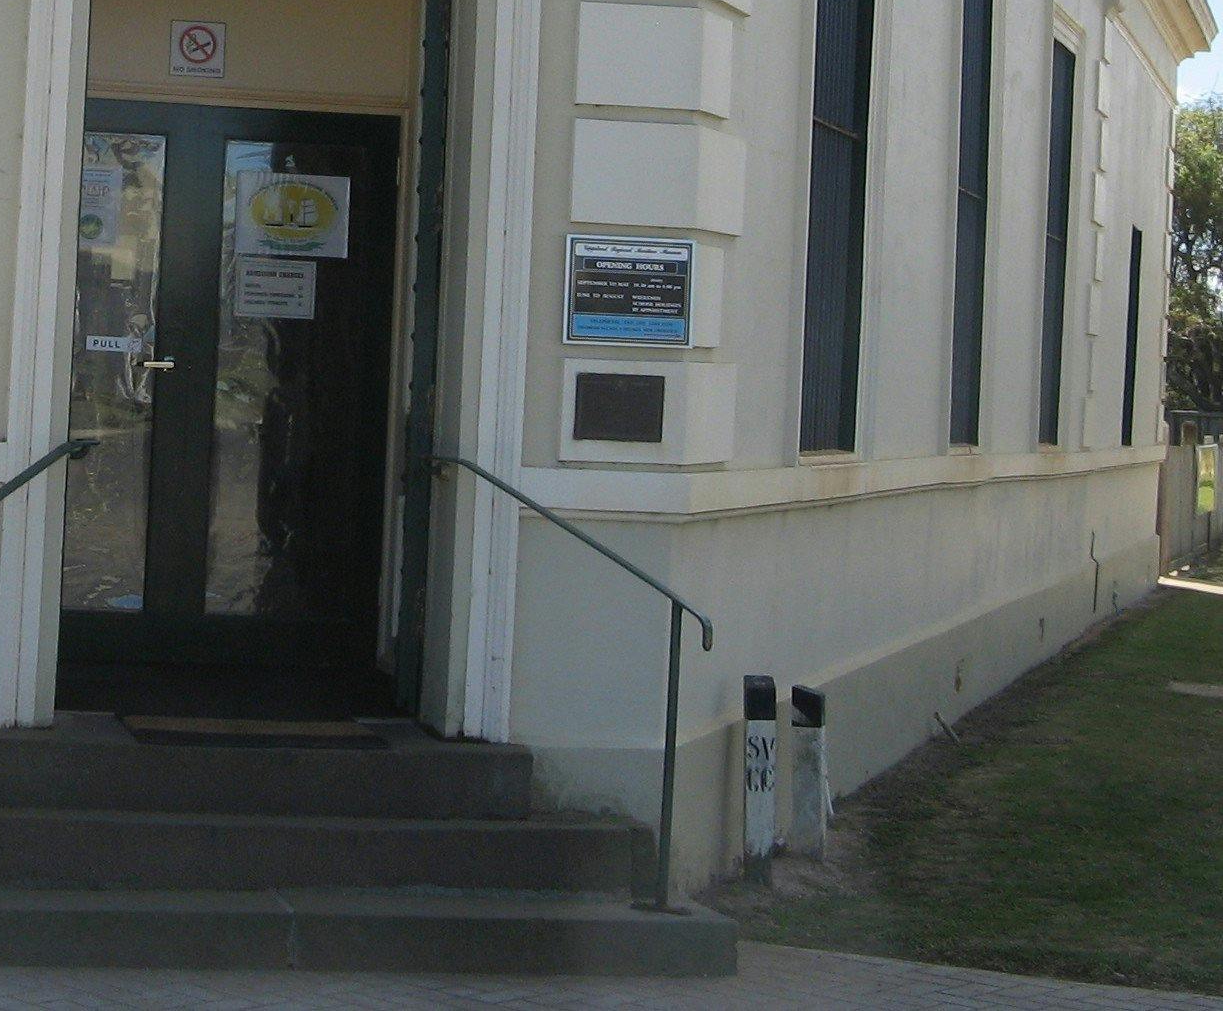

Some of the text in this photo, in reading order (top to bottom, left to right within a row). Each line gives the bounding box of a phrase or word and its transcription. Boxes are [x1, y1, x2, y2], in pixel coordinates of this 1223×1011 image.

[596, 261, 665, 271] OPENING HOURS
[93, 339, 121, 349] PULL
